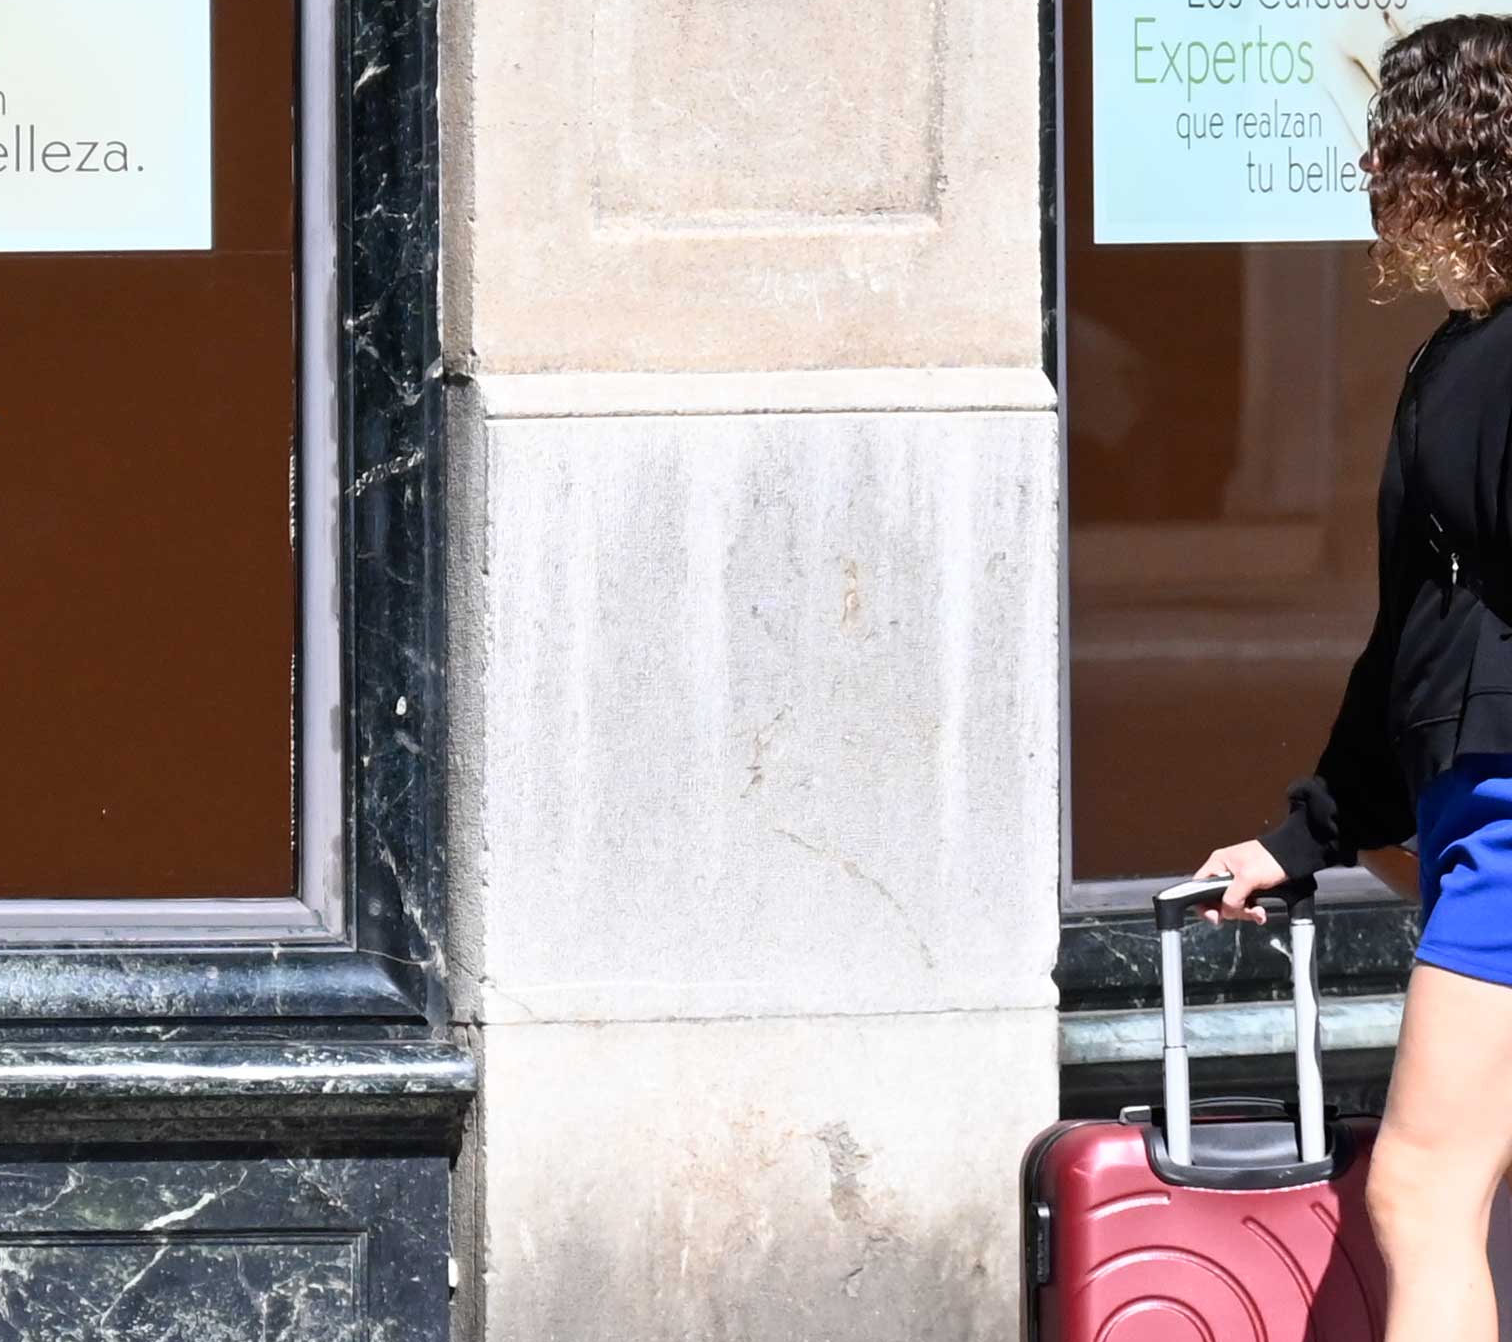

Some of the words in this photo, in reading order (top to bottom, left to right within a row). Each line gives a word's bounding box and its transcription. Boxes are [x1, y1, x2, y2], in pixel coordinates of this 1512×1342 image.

[1133, 17, 1315, 101] Expertos
[1177, 113, 1223, 149] que
[1236, 99, 1321, 139] realzan
[1245, 150, 1275, 194] tu
